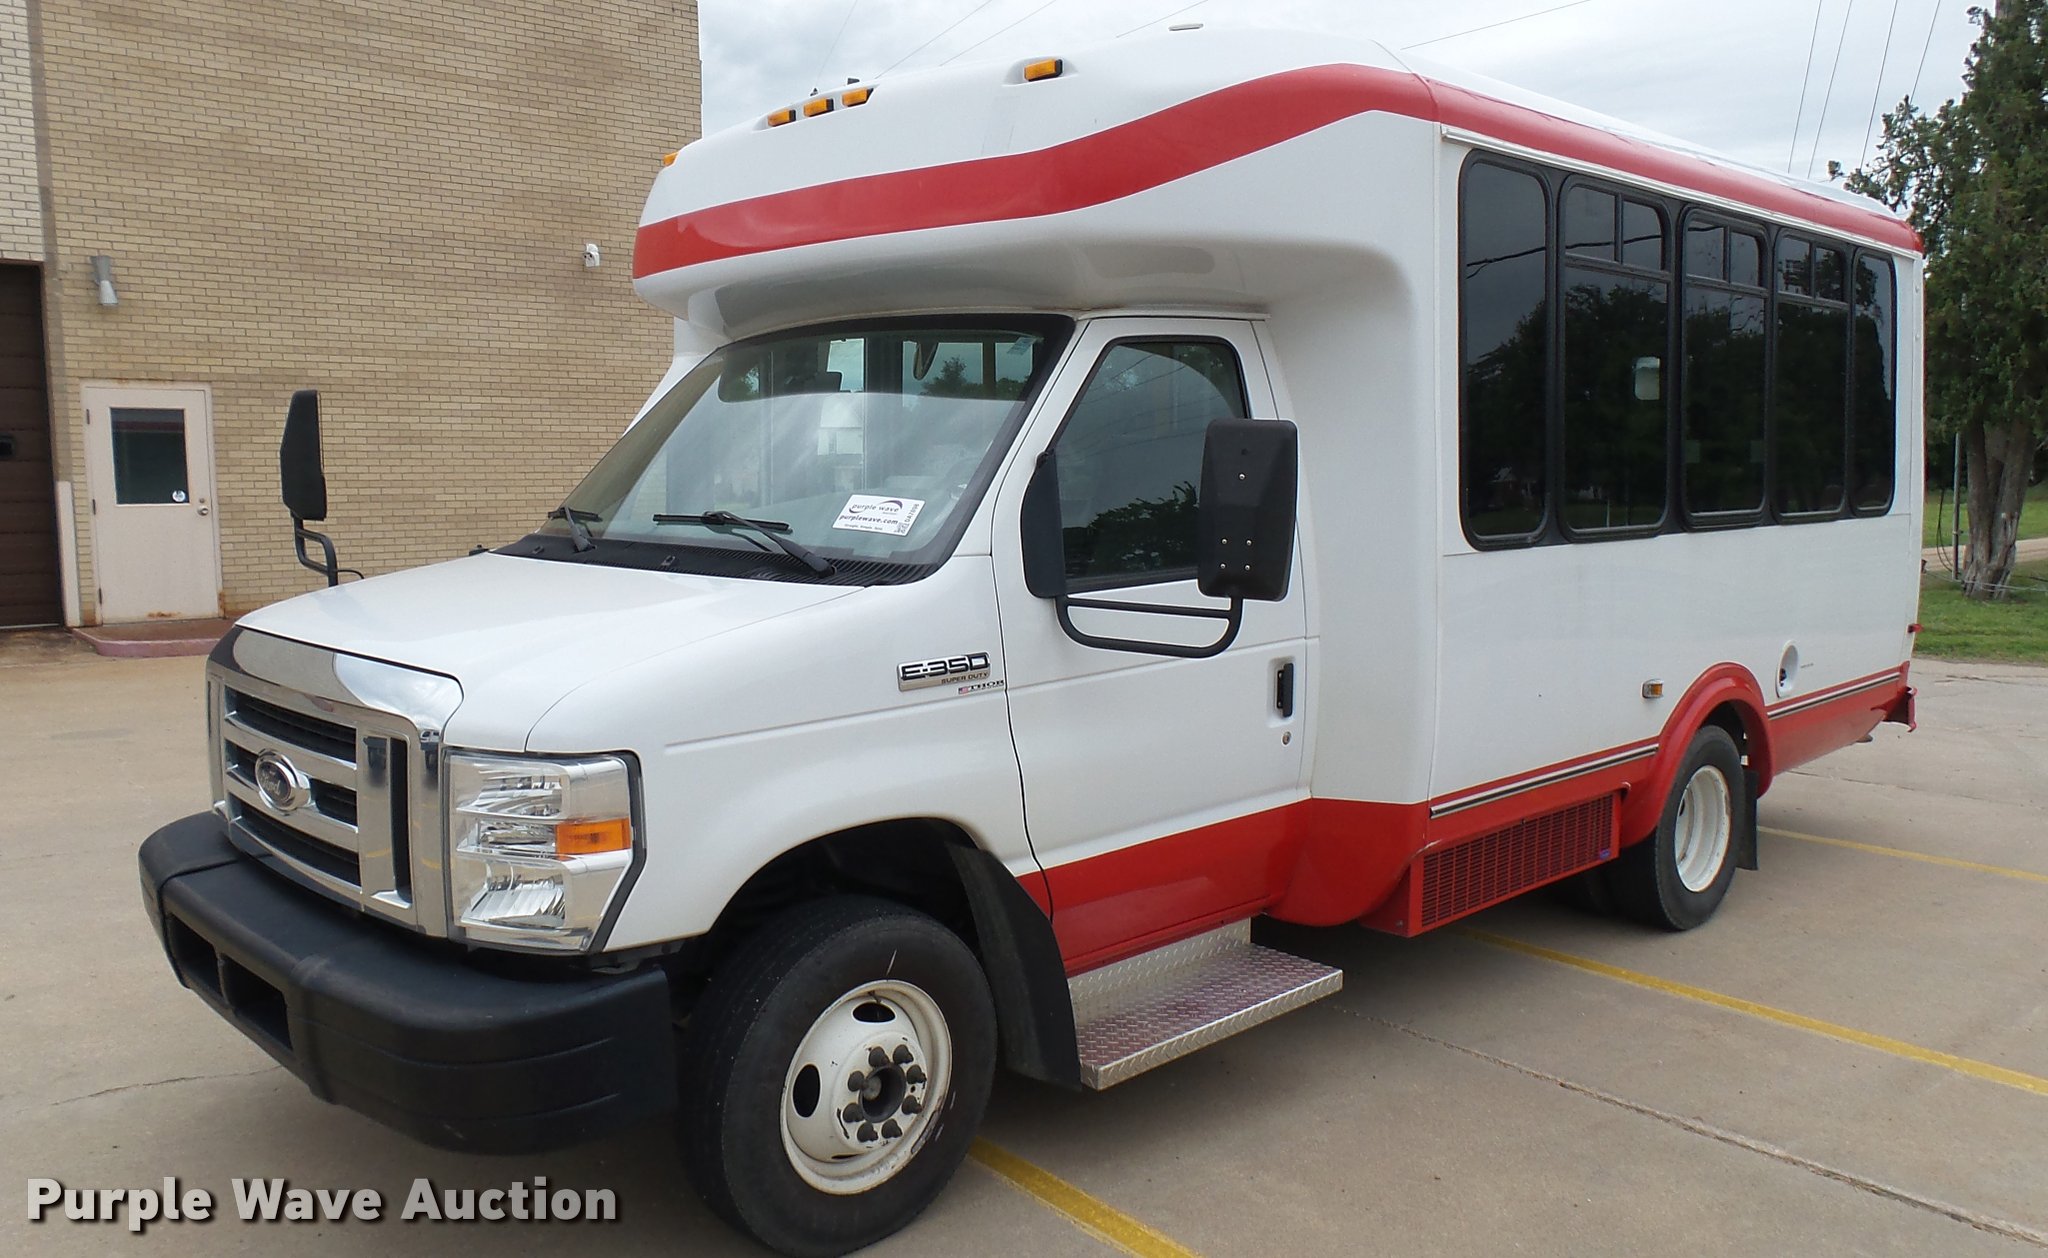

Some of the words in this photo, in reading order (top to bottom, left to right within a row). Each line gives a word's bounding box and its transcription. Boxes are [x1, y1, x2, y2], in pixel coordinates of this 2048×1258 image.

[851, 503, 877, 511] purple
[839, 514, 899, 525] purplewave.com
[941, 675, 967, 685] SUPER
[968, 672, 988, 681] DUTY
